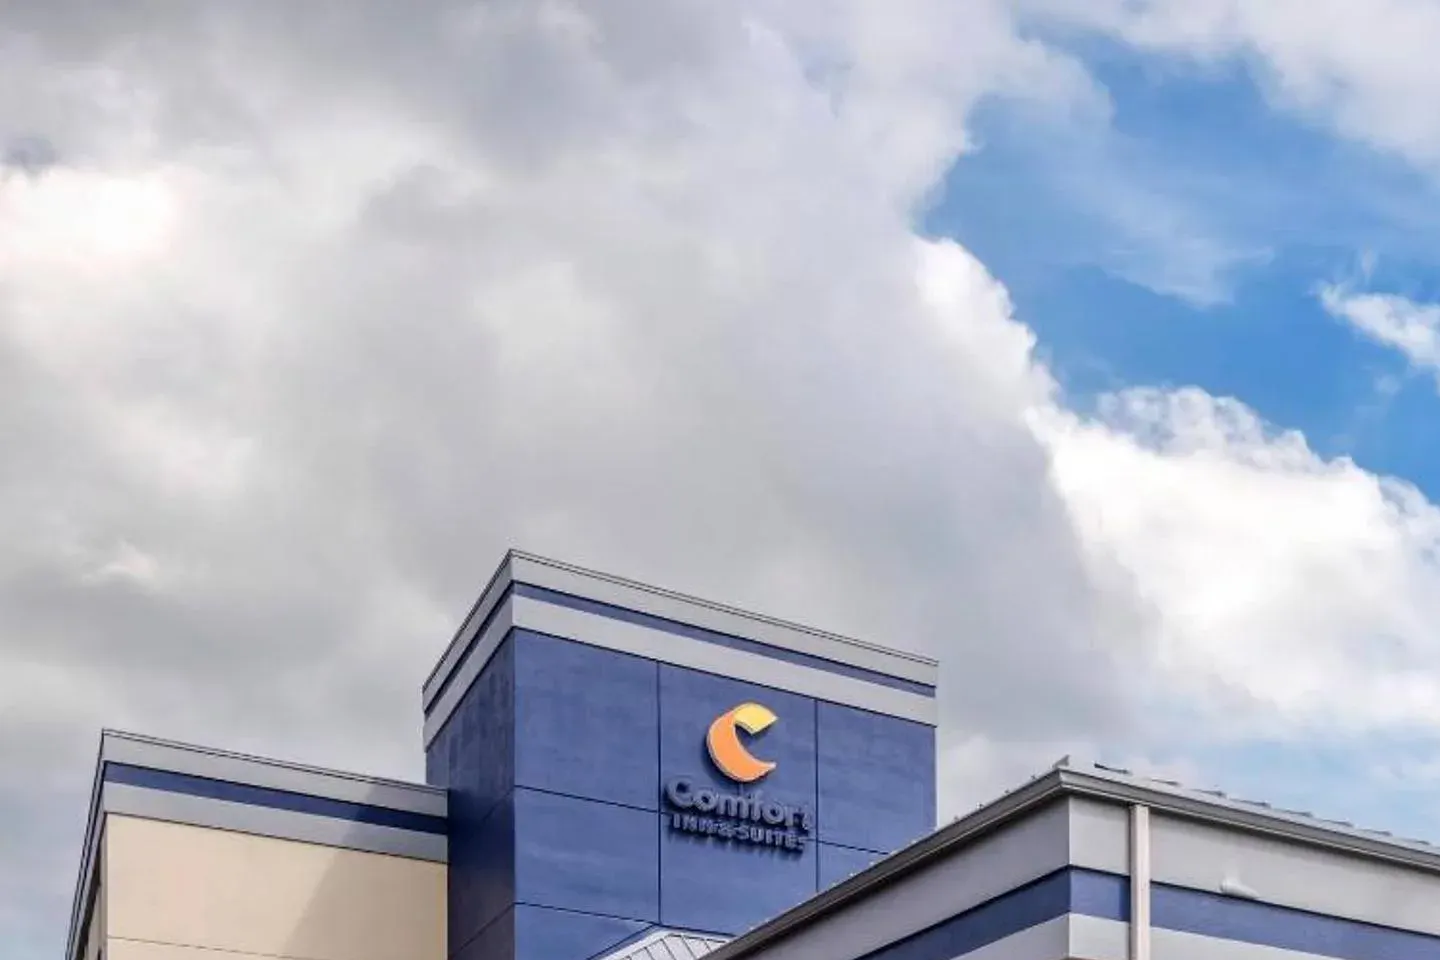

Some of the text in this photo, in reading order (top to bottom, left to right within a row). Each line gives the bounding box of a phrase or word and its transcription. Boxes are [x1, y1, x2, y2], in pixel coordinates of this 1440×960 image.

[666, 776, 812, 830] Comfort
[672, 813, 718, 834] INN
[735, 824, 806, 850] SUITES
